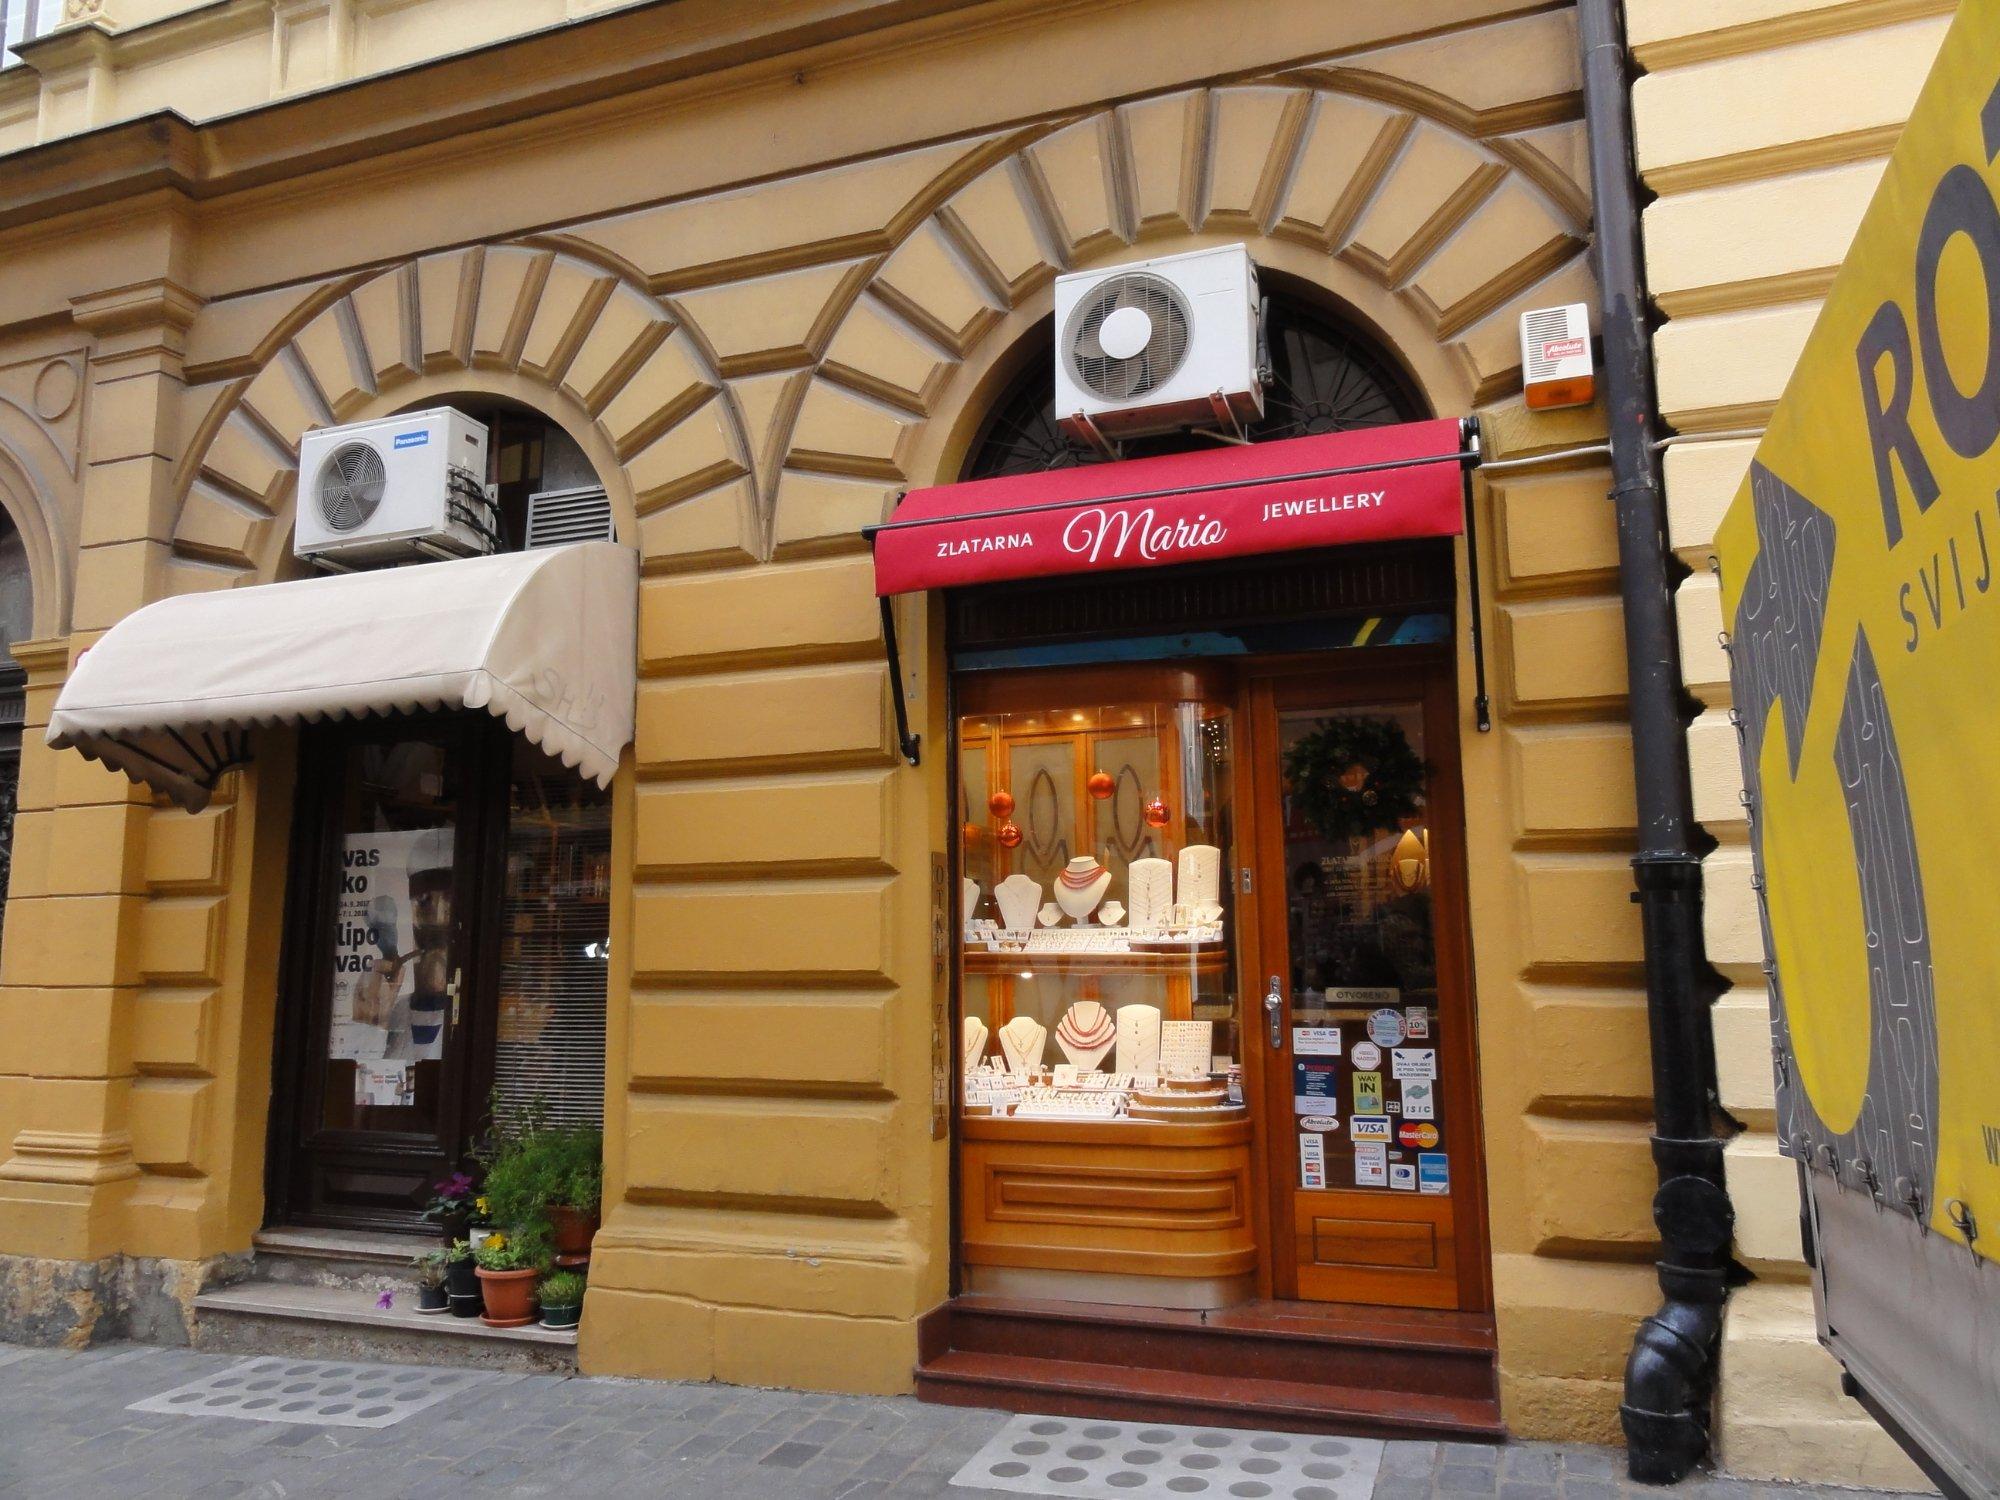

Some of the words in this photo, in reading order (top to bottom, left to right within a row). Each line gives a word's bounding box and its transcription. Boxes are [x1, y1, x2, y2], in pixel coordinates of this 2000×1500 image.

[395, 433, 428, 447] Panasonic
[936, 532, 1034, 558] ZLATARNA
[1062, 508, 1228, 564] Mario
[1262, 490, 1386, 523] JEWELLERY
[1899, 488, 2000, 654] SVIJ
[342, 848, 380, 868] vas
[341, 871, 368, 894] ko
[934, 865, 945, 984] OTKUP
[336, 921, 380, 952] lipo
[336, 953, 374, 973] vac
[1336, 991, 1390, 999] OTVORENO
[934, 1003, 945, 1122] ZLATA
[1360, 1083, 1376, 1093] IN
[1357, 1123, 1385, 1133] VISA
[1399, 1130, 1439, 1139] MasterCard
